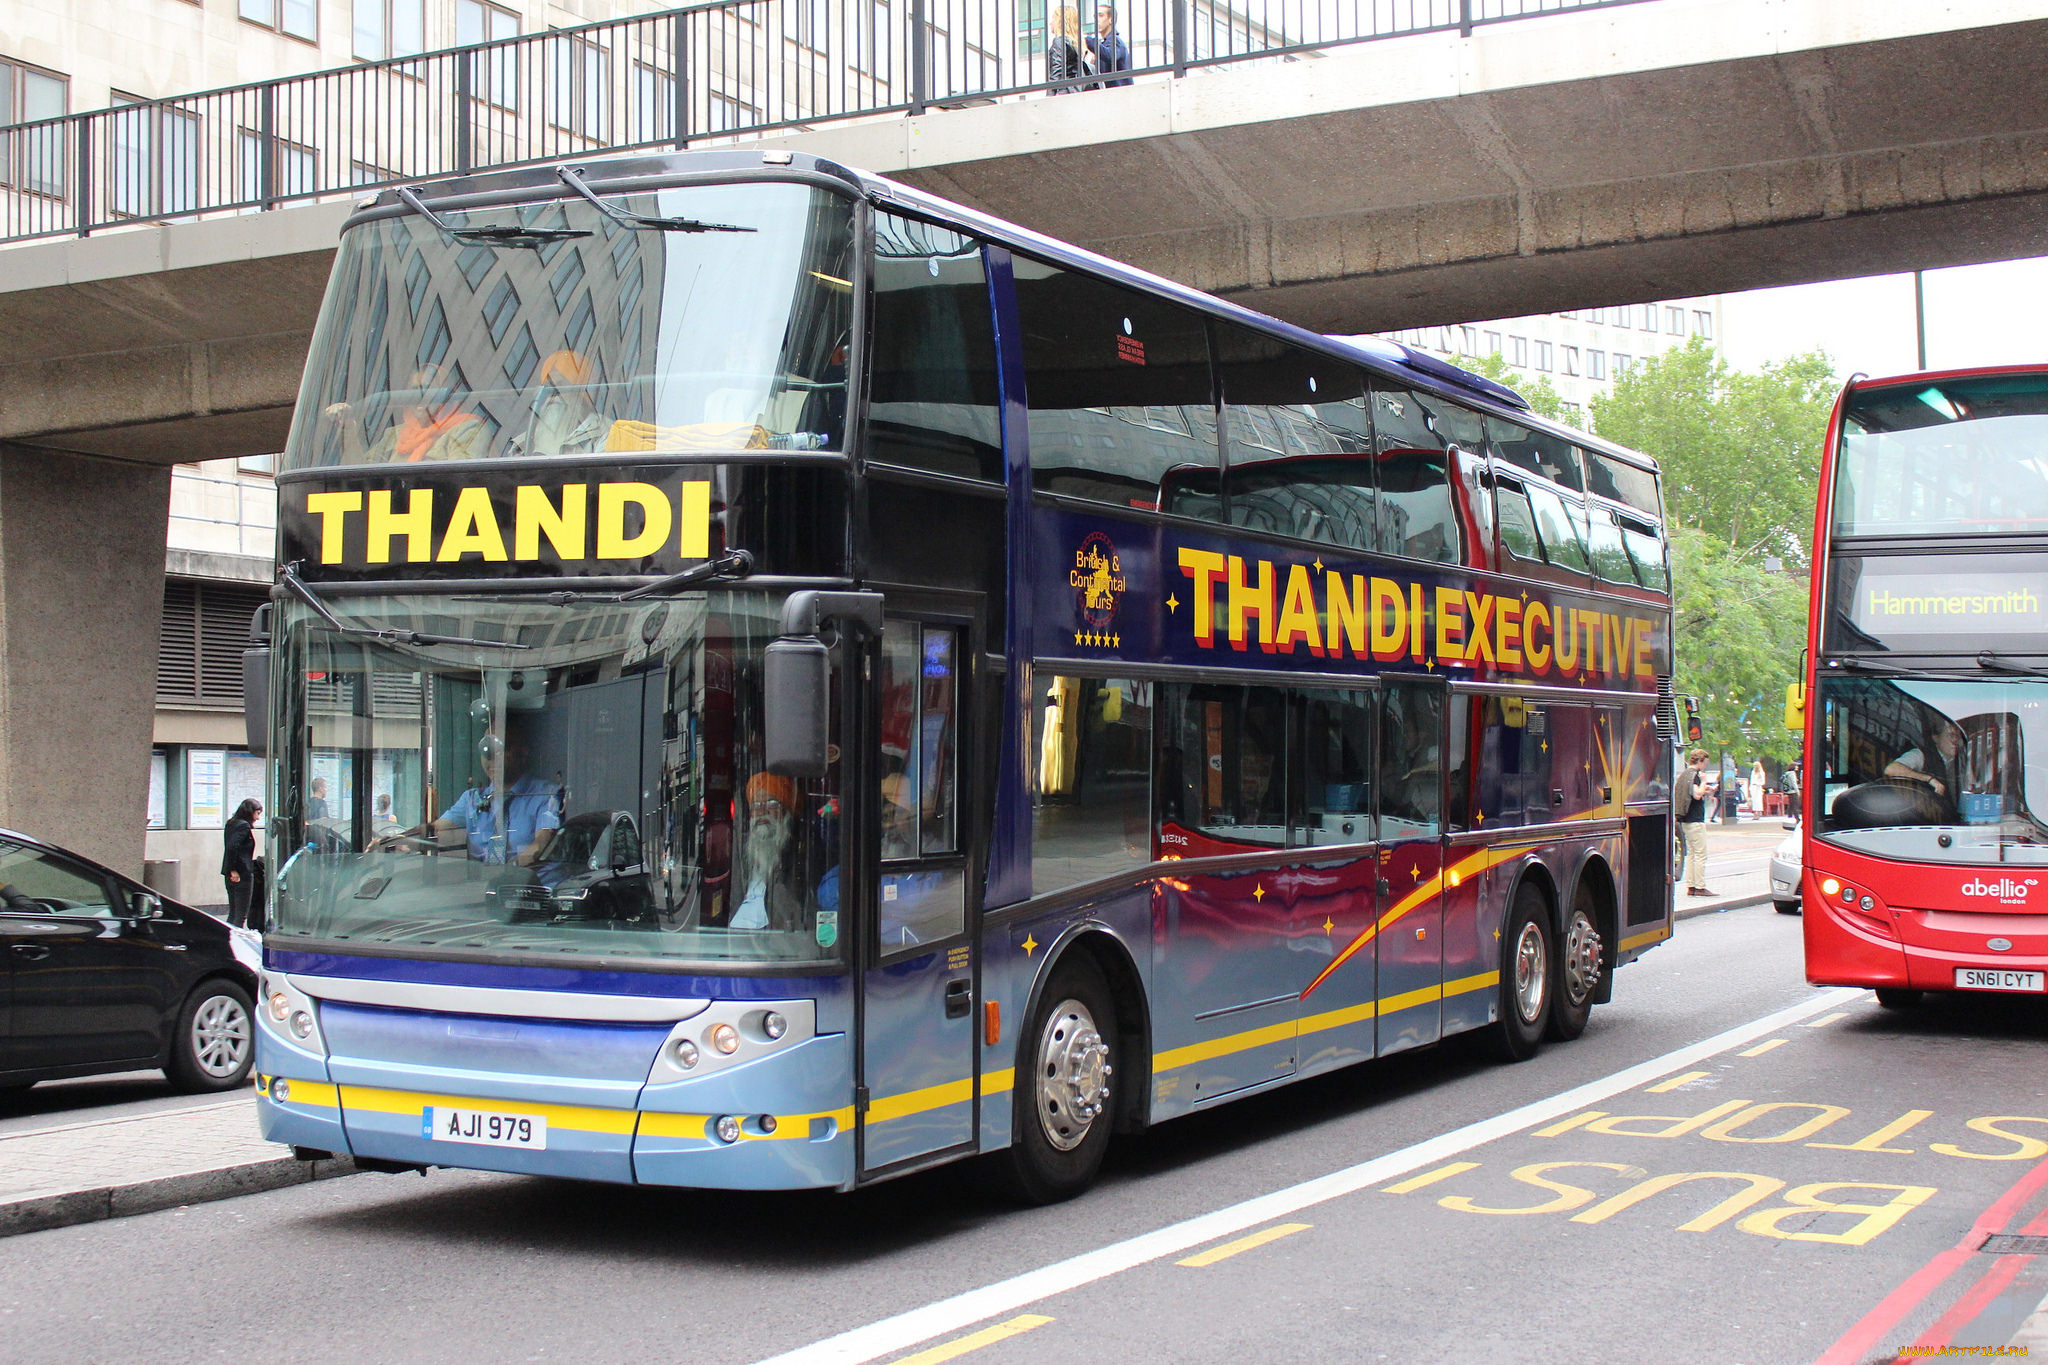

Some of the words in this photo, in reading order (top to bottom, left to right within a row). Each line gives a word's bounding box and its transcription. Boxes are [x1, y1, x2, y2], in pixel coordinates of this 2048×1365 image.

[308, 481, 710, 565] THANDI
[1112, 555, 1120, 572] &
[1178, 547, 1426, 659] THANDI
[1436, 586, 1655, 681] EXECUTIVE
[1870, 587, 2038, 615] Hammersmith
[1962, 878, 2027, 897] abellio
[1966, 972, 2000, 985] SN61
[2004, 973, 2034, 987] CYT
[1585, 1100, 2048, 1160] STOP
[1437, 1161, 1939, 1246] BUS
